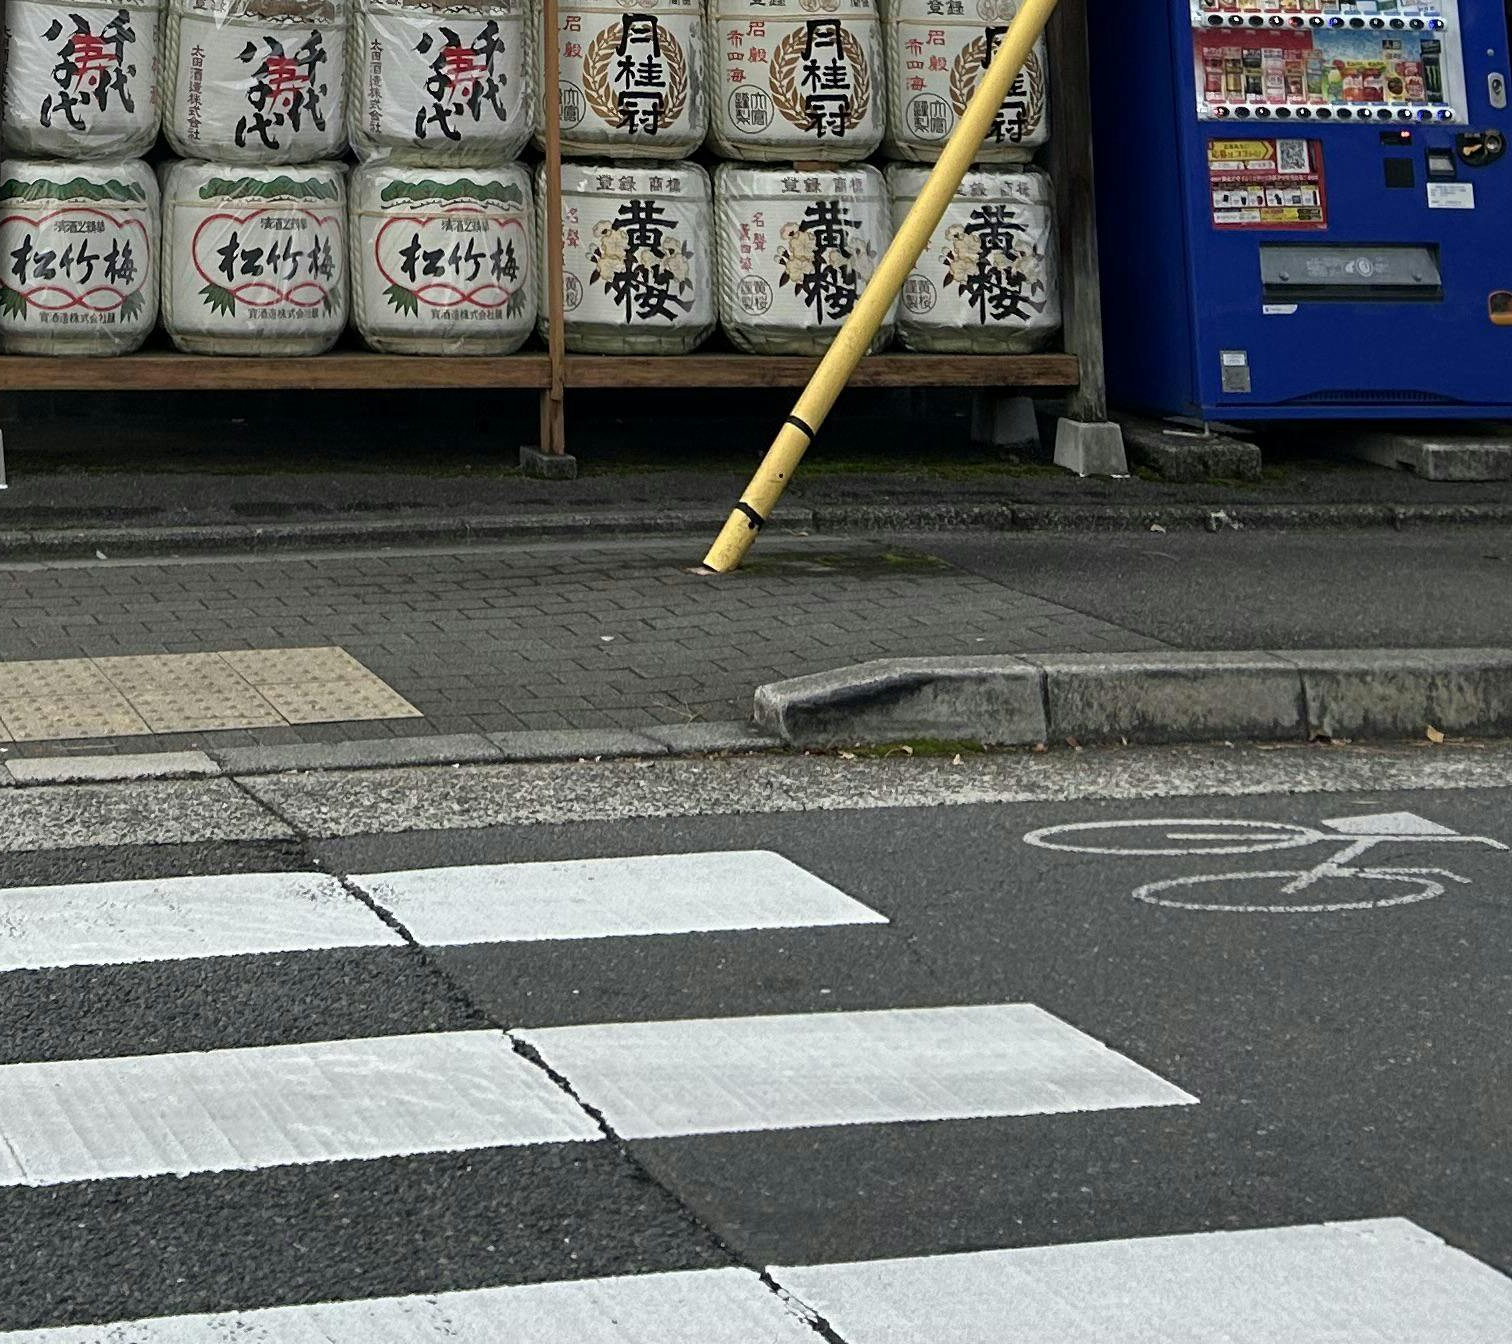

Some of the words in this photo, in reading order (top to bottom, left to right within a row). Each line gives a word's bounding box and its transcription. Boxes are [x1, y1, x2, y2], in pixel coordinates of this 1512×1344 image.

[614, 13, 666, 135] 月桂冠
[801, 19, 852, 138] 月桂冠
[10, 234, 138, 285] 松竹梅
[217, 231, 335, 282] 松竹梅
[399, 232, 520, 282] 松竹梅
[611, 200, 695, 325] 黄桜
[799, 200, 862, 325] 黄桜
[964, 205, 1047, 325] 黄桜
